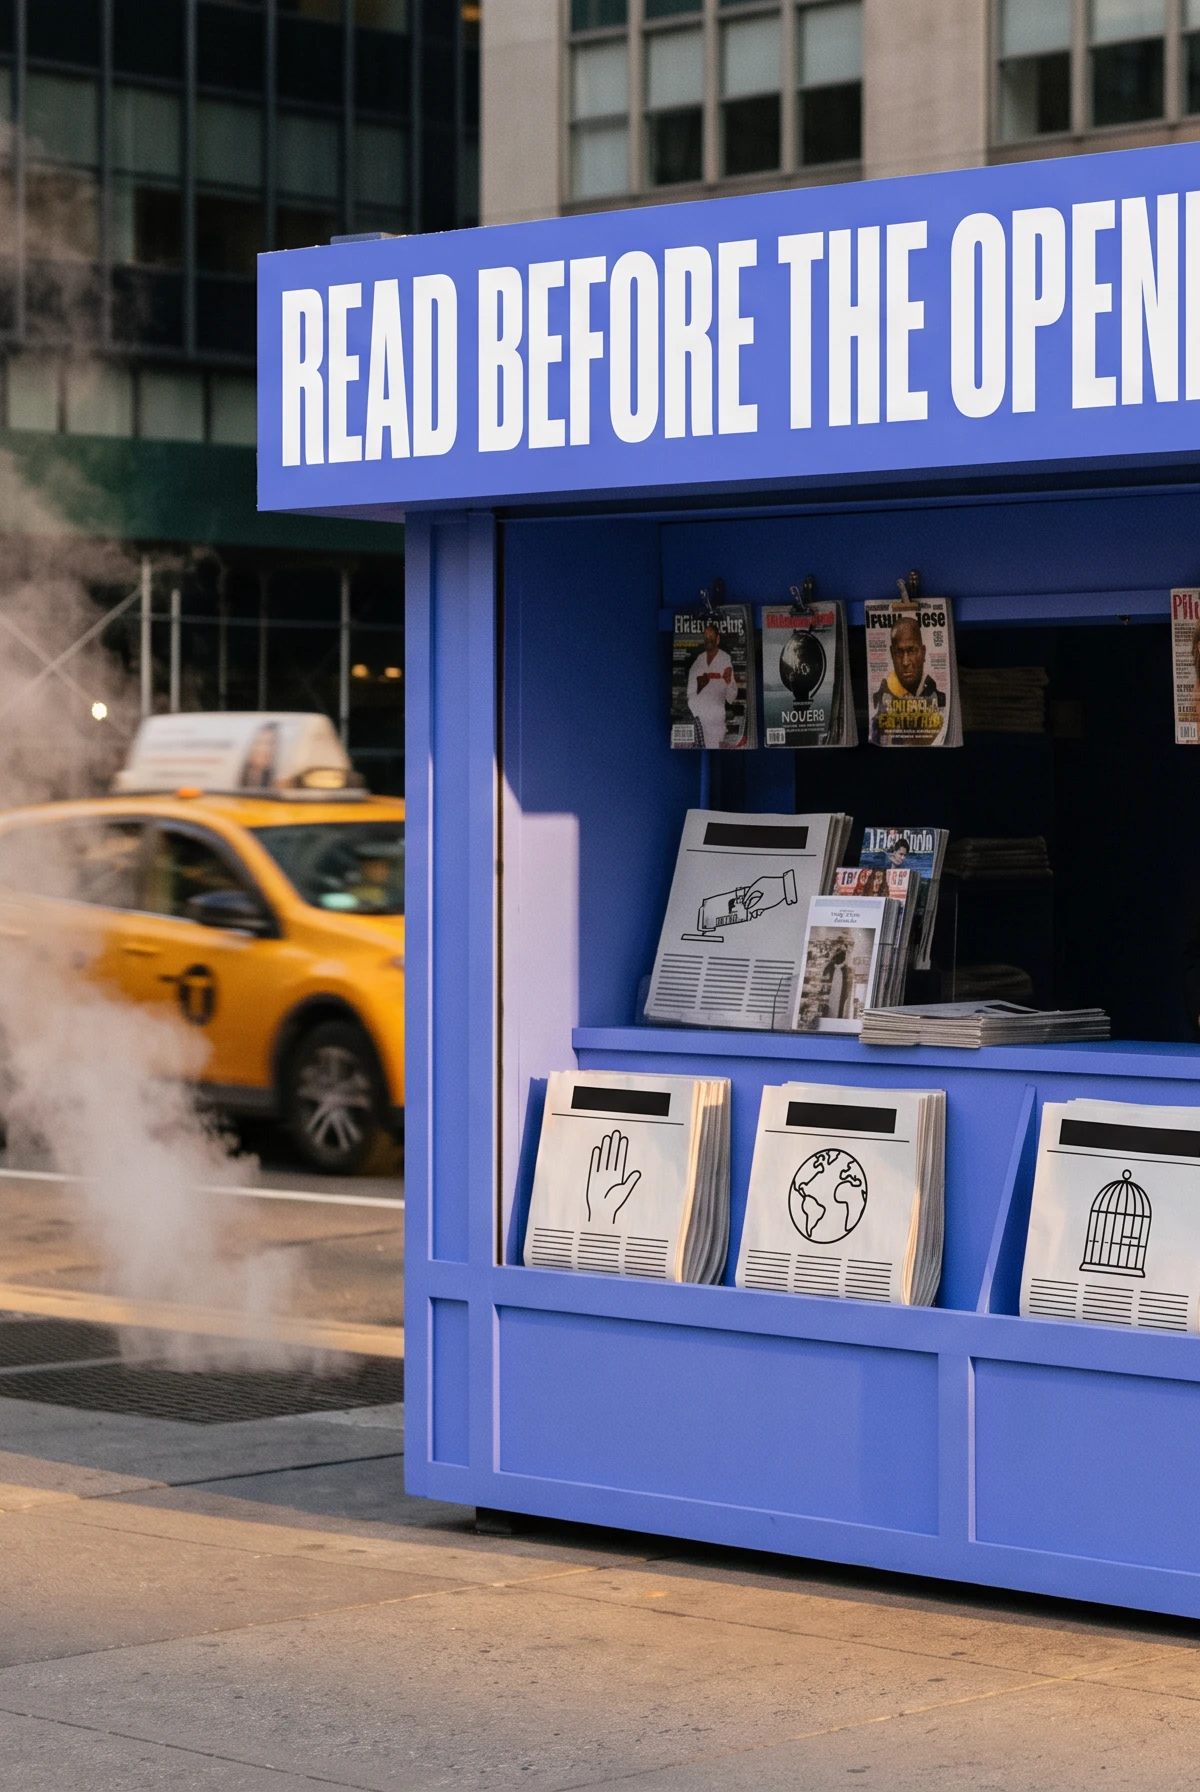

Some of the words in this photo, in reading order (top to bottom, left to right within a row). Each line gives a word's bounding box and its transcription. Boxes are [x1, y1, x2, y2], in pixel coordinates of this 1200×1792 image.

[282, 273, 458, 467] READ
[478, 238, 758, 453] BEFORE
[778, 220, 928, 430] THE
